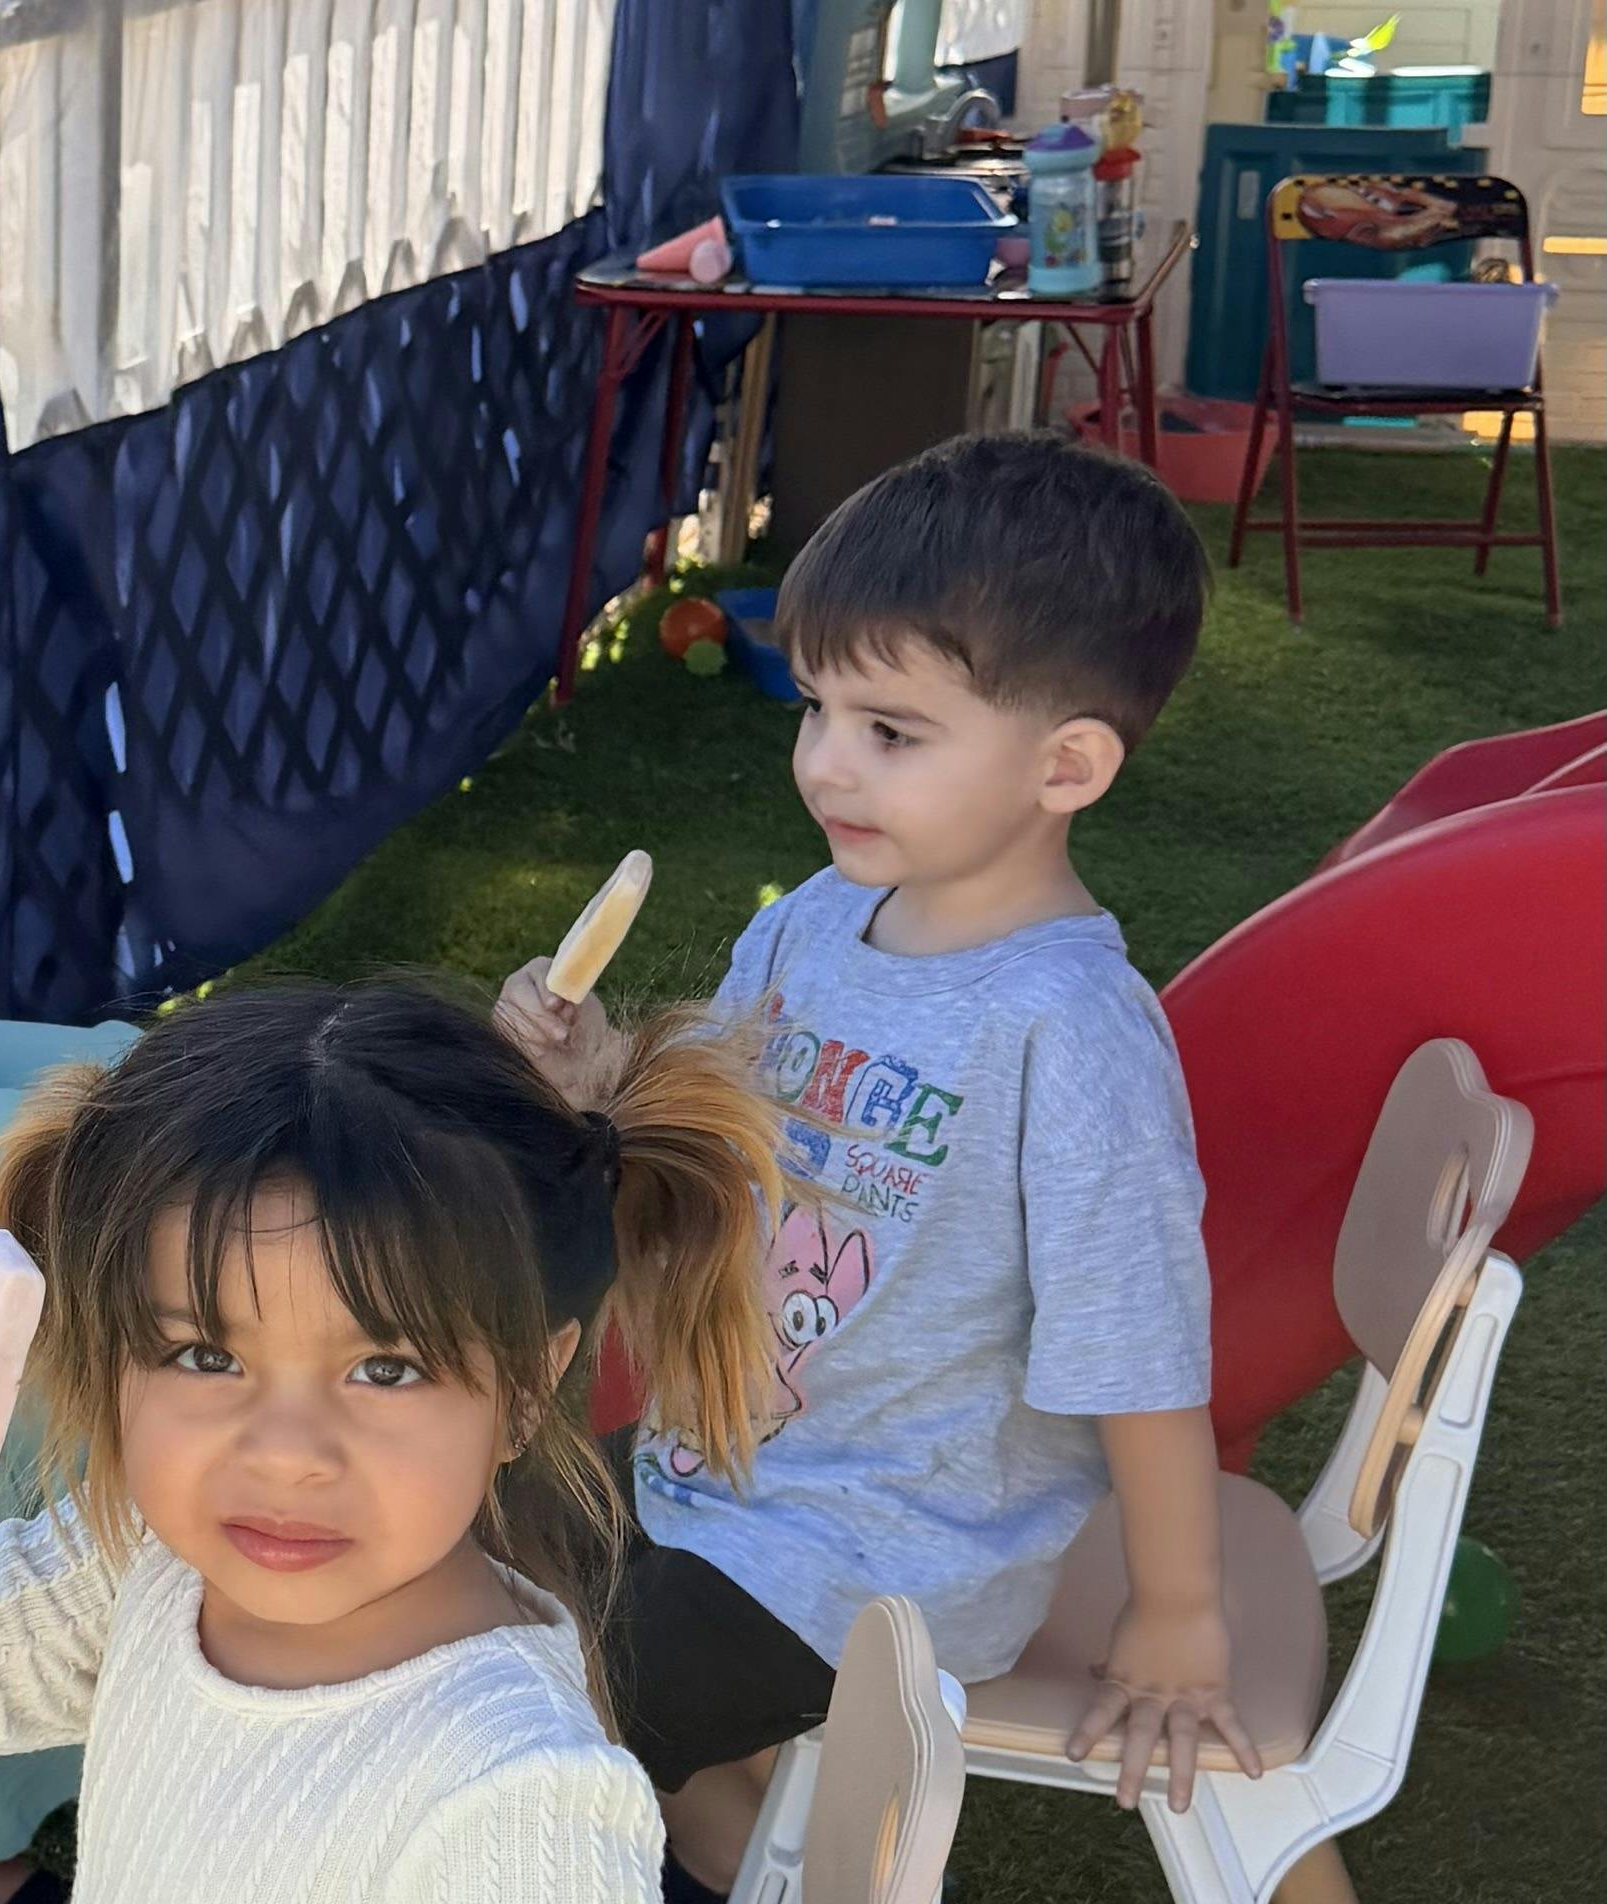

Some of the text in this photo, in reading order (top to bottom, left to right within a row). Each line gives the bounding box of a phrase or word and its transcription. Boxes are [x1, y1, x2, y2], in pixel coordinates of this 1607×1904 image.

[760, 994, 964, 1167] ONGE
[845, 1143, 929, 1195] SQUARE
[842, 1174, 919, 1223] PANTS
